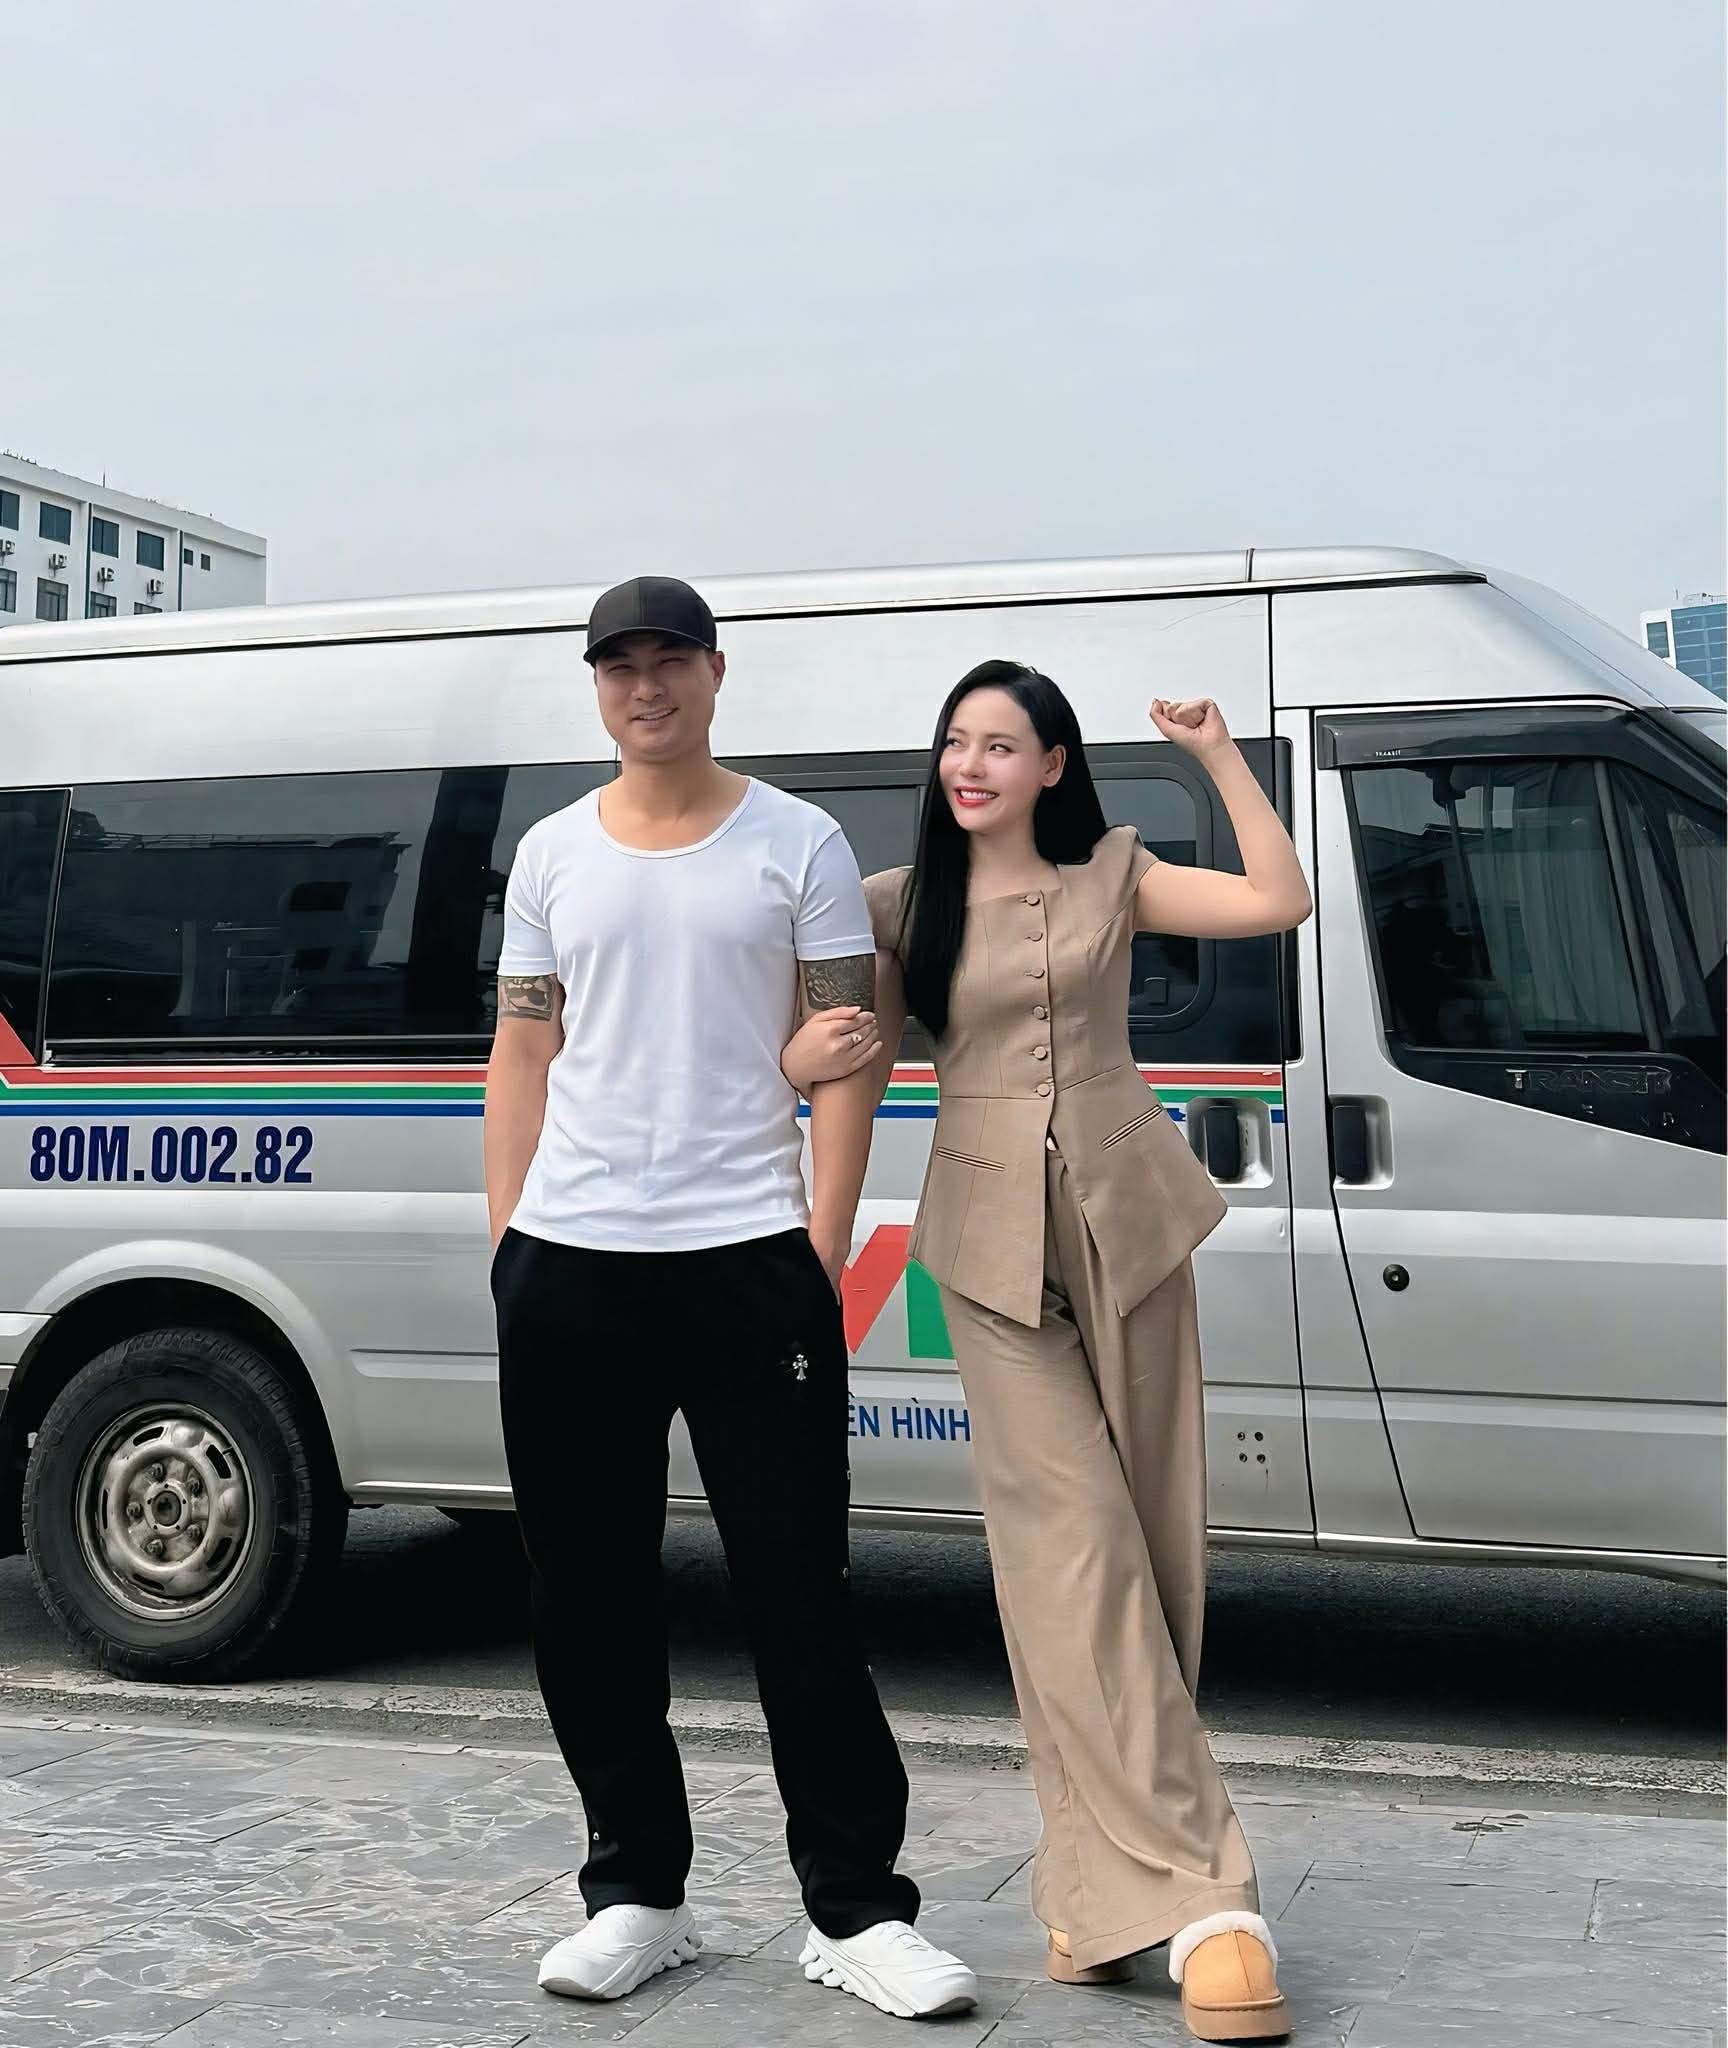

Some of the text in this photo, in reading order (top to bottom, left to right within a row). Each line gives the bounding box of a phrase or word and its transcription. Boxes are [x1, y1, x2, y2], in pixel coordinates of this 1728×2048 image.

[30, 1125, 313, 1183] 80M.002.82
[848, 1391, 971, 1442] ỀN HÌNH
